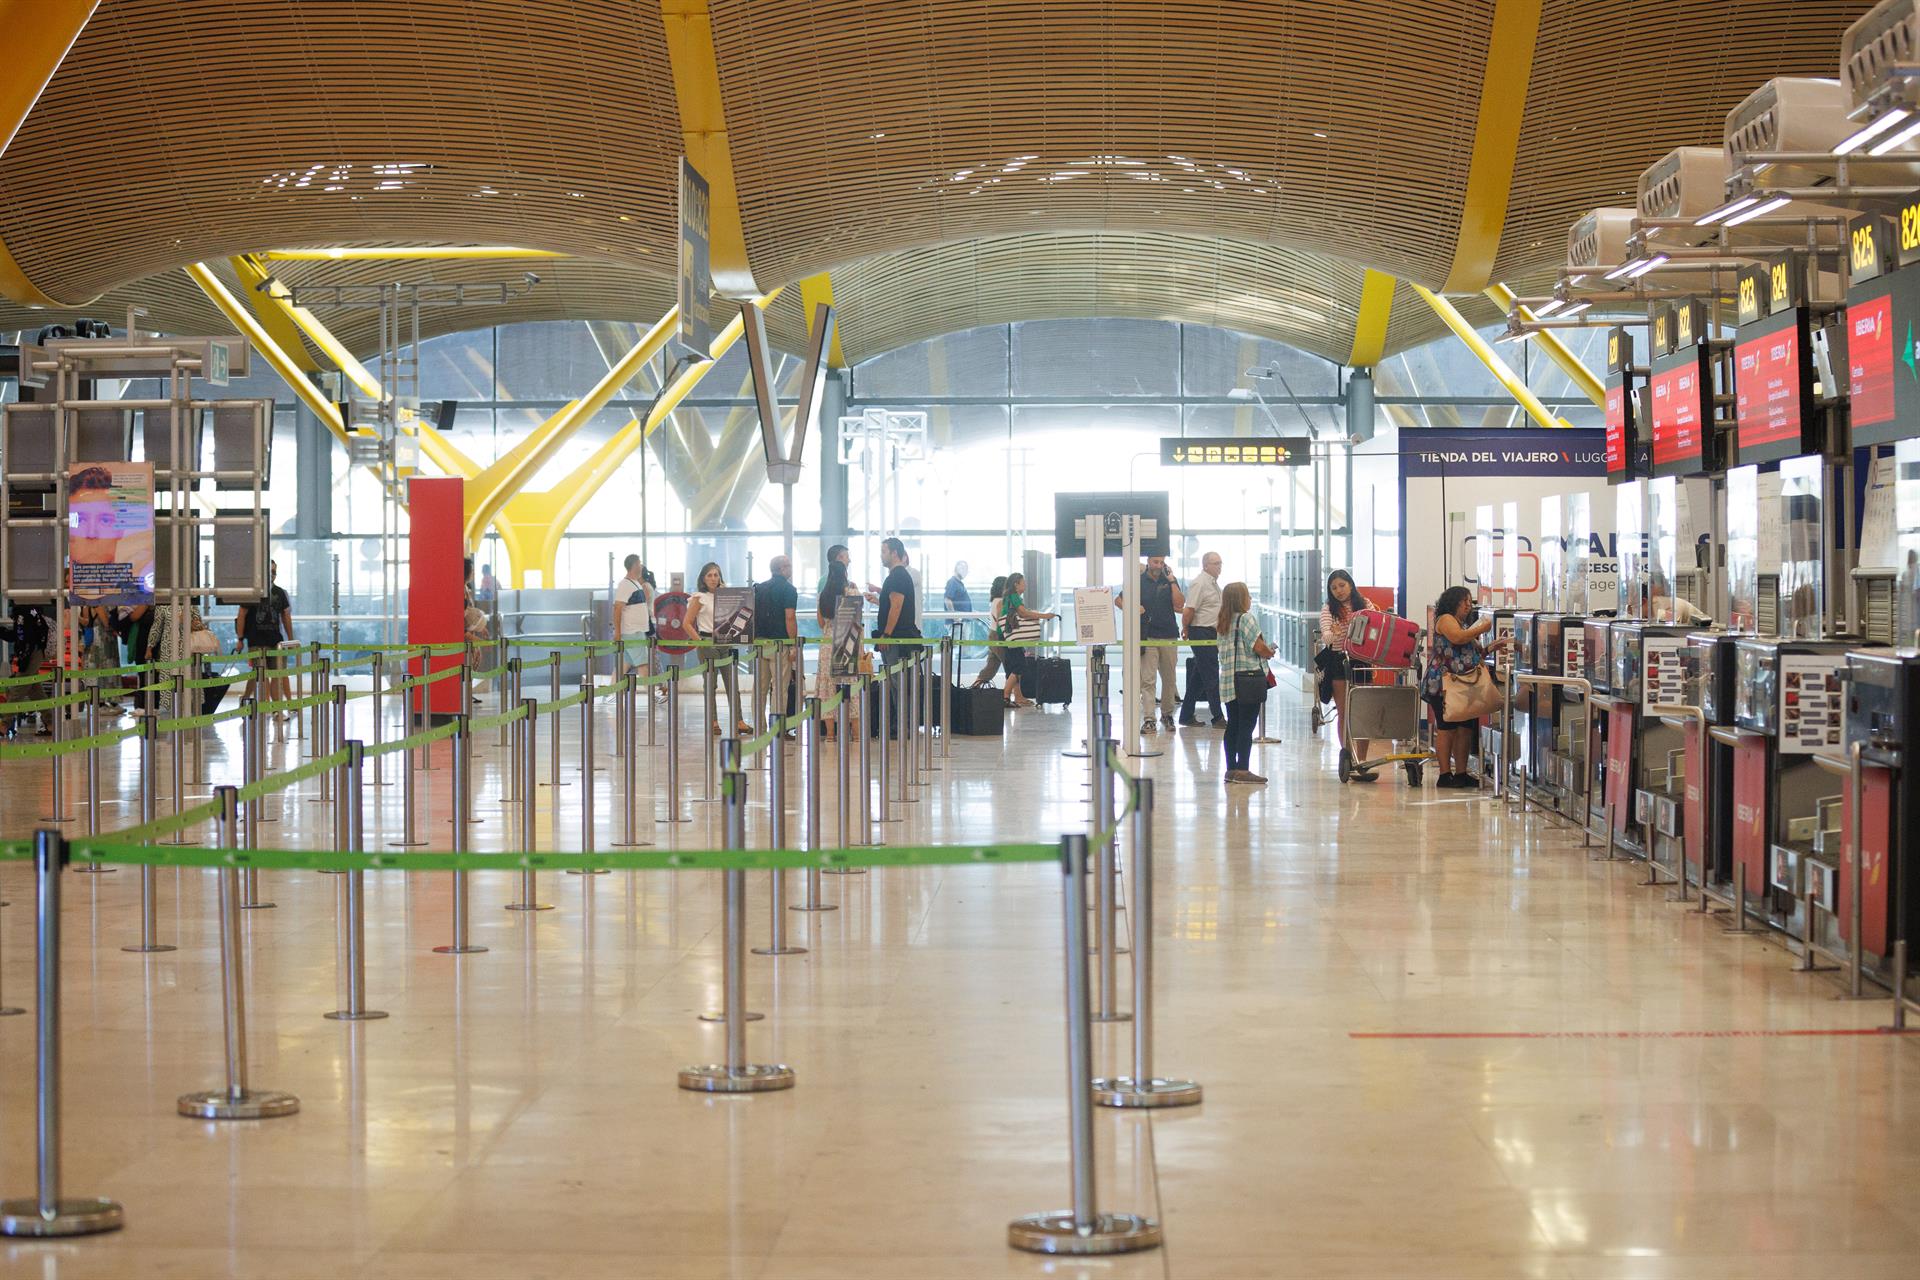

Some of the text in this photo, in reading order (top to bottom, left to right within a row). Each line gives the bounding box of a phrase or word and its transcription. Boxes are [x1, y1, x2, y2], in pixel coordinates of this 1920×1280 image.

[1853, 225, 1874, 270] 825
[1741, 277, 1755, 314] 823
[1772, 263, 1787, 301] 824
[1656, 316, 1665, 347] 821
[1680, 305, 1690, 338] 822
[1856, 316, 1875, 336] IBERIA
[1771, 344, 1786, 361] IBERIA
[1420, 453, 1468, 462] TIENDA
[1472, 453, 1497, 462] DEL
[1502, 453, 1558, 463] VIAJERO
